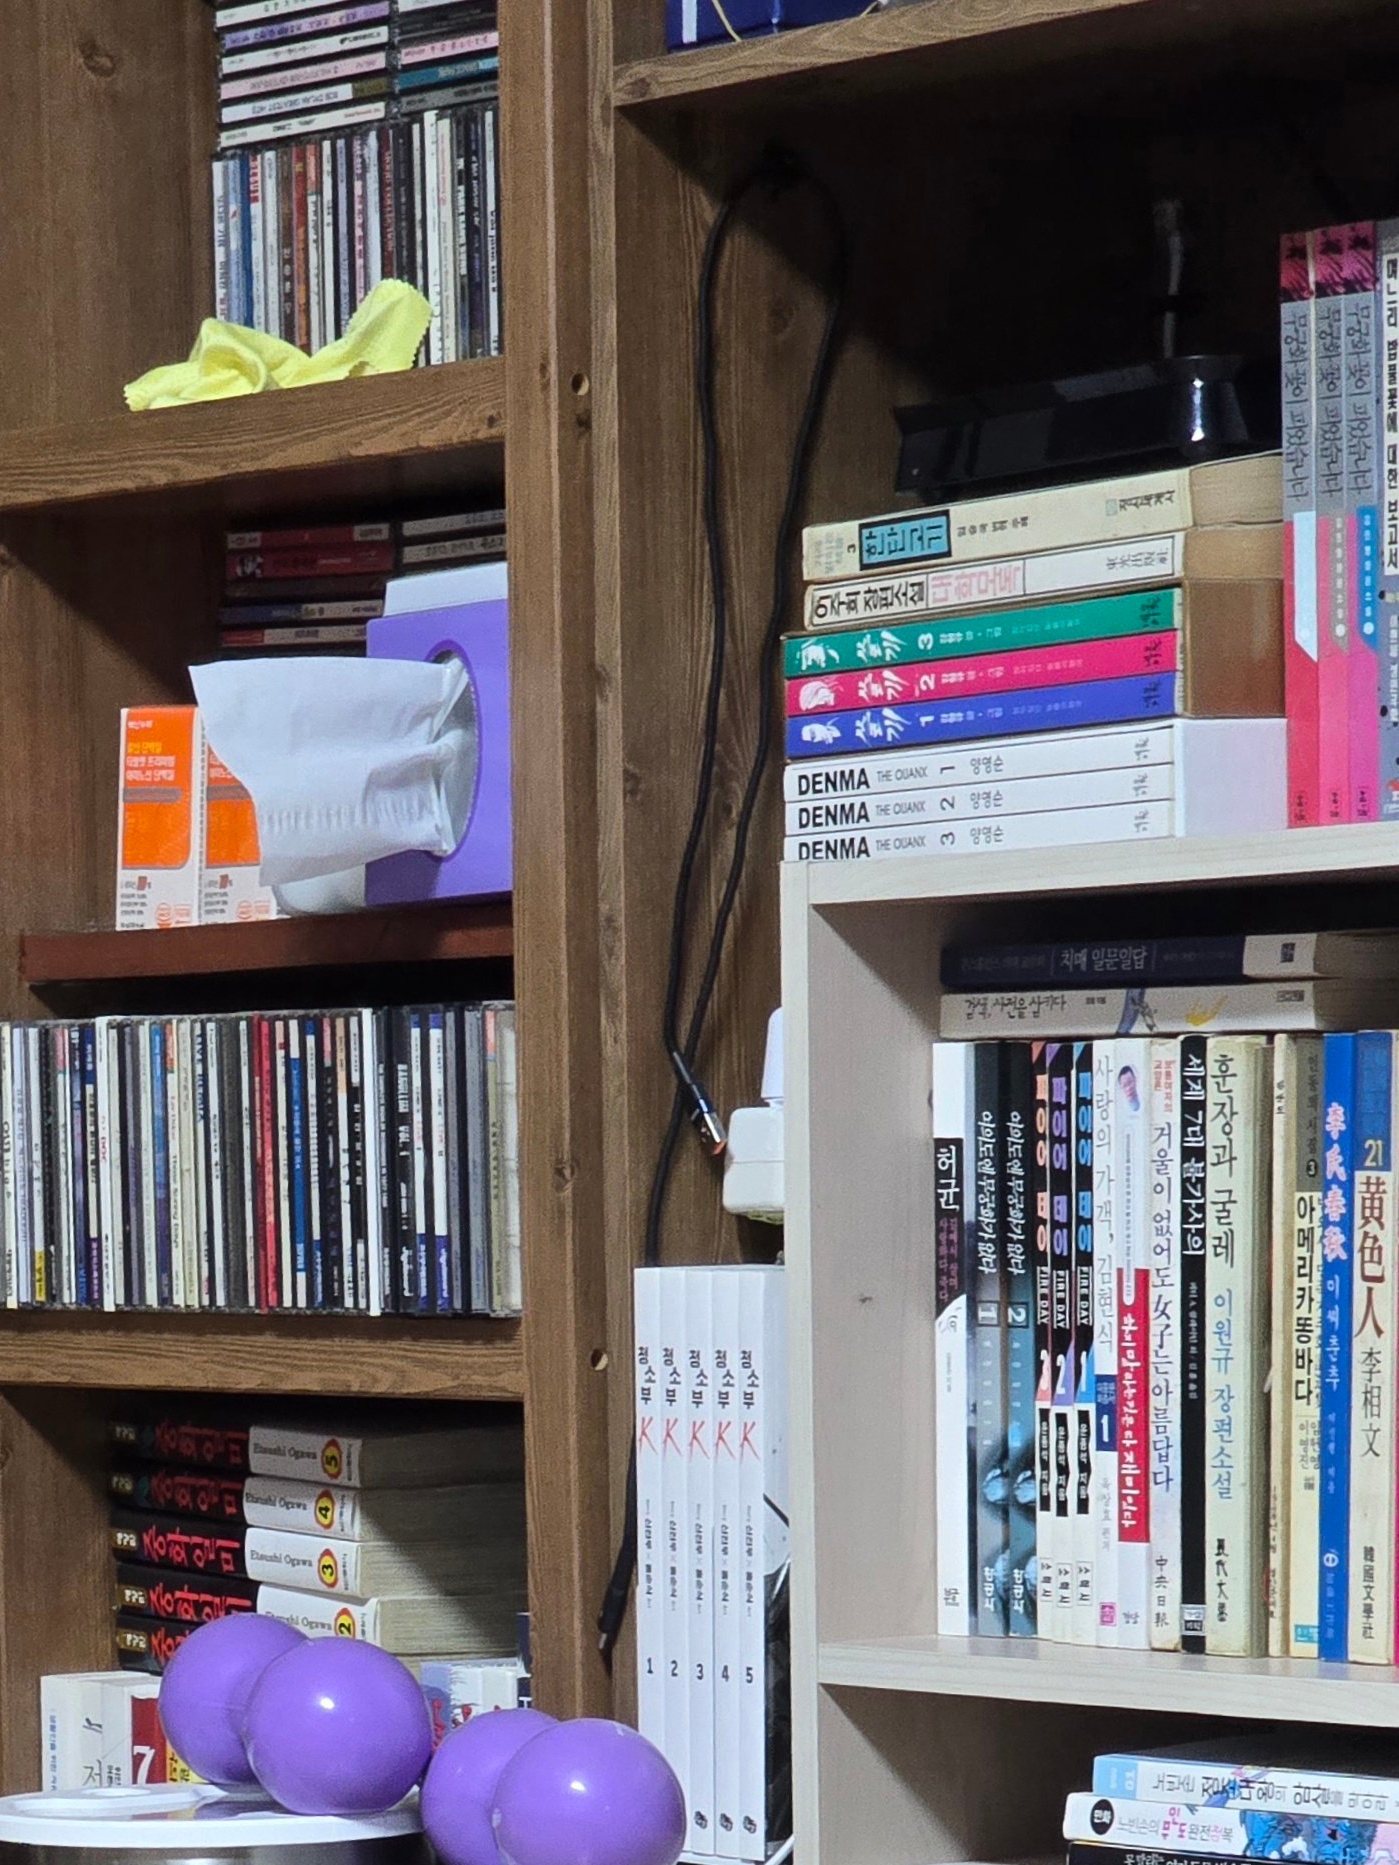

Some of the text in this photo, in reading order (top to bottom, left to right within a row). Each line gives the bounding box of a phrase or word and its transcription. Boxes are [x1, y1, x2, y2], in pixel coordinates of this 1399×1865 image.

[1284, 411, 1309, 501] 피었습니다
[1319, 406, 1344, 495] 피었습니다
[865, 525, 943, 558] 한단고기
[863, 581, 925, 610] 장편소설
[918, 633, 933, 650] 3
[920, 674, 935, 691] 2
[919, 715, 934, 727] 1
[797, 755, 1004, 795] DENMA THE QUANX 1 양영순
[799, 790, 1003, 829] DENMA THE QUANX 2 양영순
[799, 837, 891, 861] DENMA THE
[1060, 948, 1088, 973] 치매
[1092, 945, 1149, 973] 일문일답
[1095, 1055, 1113, 1151] 사랑의
[1182, 1054, 1206, 1256] 세계 7대 불가사의
[1364, 1140, 1383, 1167] 21
[977, 1177, 997, 1276] 무궁화가 없다
[1006, 1177, 1026, 1276] 무궁화가 없다
[1295, 1194, 1316, 1315] 아메리카
[1038, 1266, 1049, 1325] FIRE DAY
[1053, 1270, 1069, 1329] FIRE DAY
[1078, 1266, 1092, 1326] FIRE DAY
[1096, 1254, 1116, 1354] 김현식
[1210, 1054, 1239, 1500] 훈장과 굴레 이원규 장편소설
[1151, 1122, 1175, 1493] 거울이 없어도 아름답다
[1294, 1316, 1315, 1407] 똥바다
[637, 1345, 659, 1457] 청소부 K
[662, 1346, 683, 1457] 청소부 K
[688, 1349, 711, 1460] 청소부 K
[1360, 1346, 1382, 1459] 李相文
[253, 1444, 285, 1458] Etsushi
[288, 1446, 317, 1461] Ogawa
[325, 1452, 338, 1468] 5
[245, 1493, 277, 1509] Etsushi
[278, 1497, 308, 1511] Ogawa
[318, 1502, 331, 1519] 4
[249, 1550, 335, 1578] Etsushi Ogawa 3
[714, 1420, 737, 1683] K 4
[303, 1615, 352, 1635] Ogawa 2
[744, 1665, 755, 1684] 5
[132, 1745, 155, 1785] 7
[1152, 1772, 1195, 1793] 노빈손
[1117, 1818, 1234, 1843] 노빈손의 완전정복
